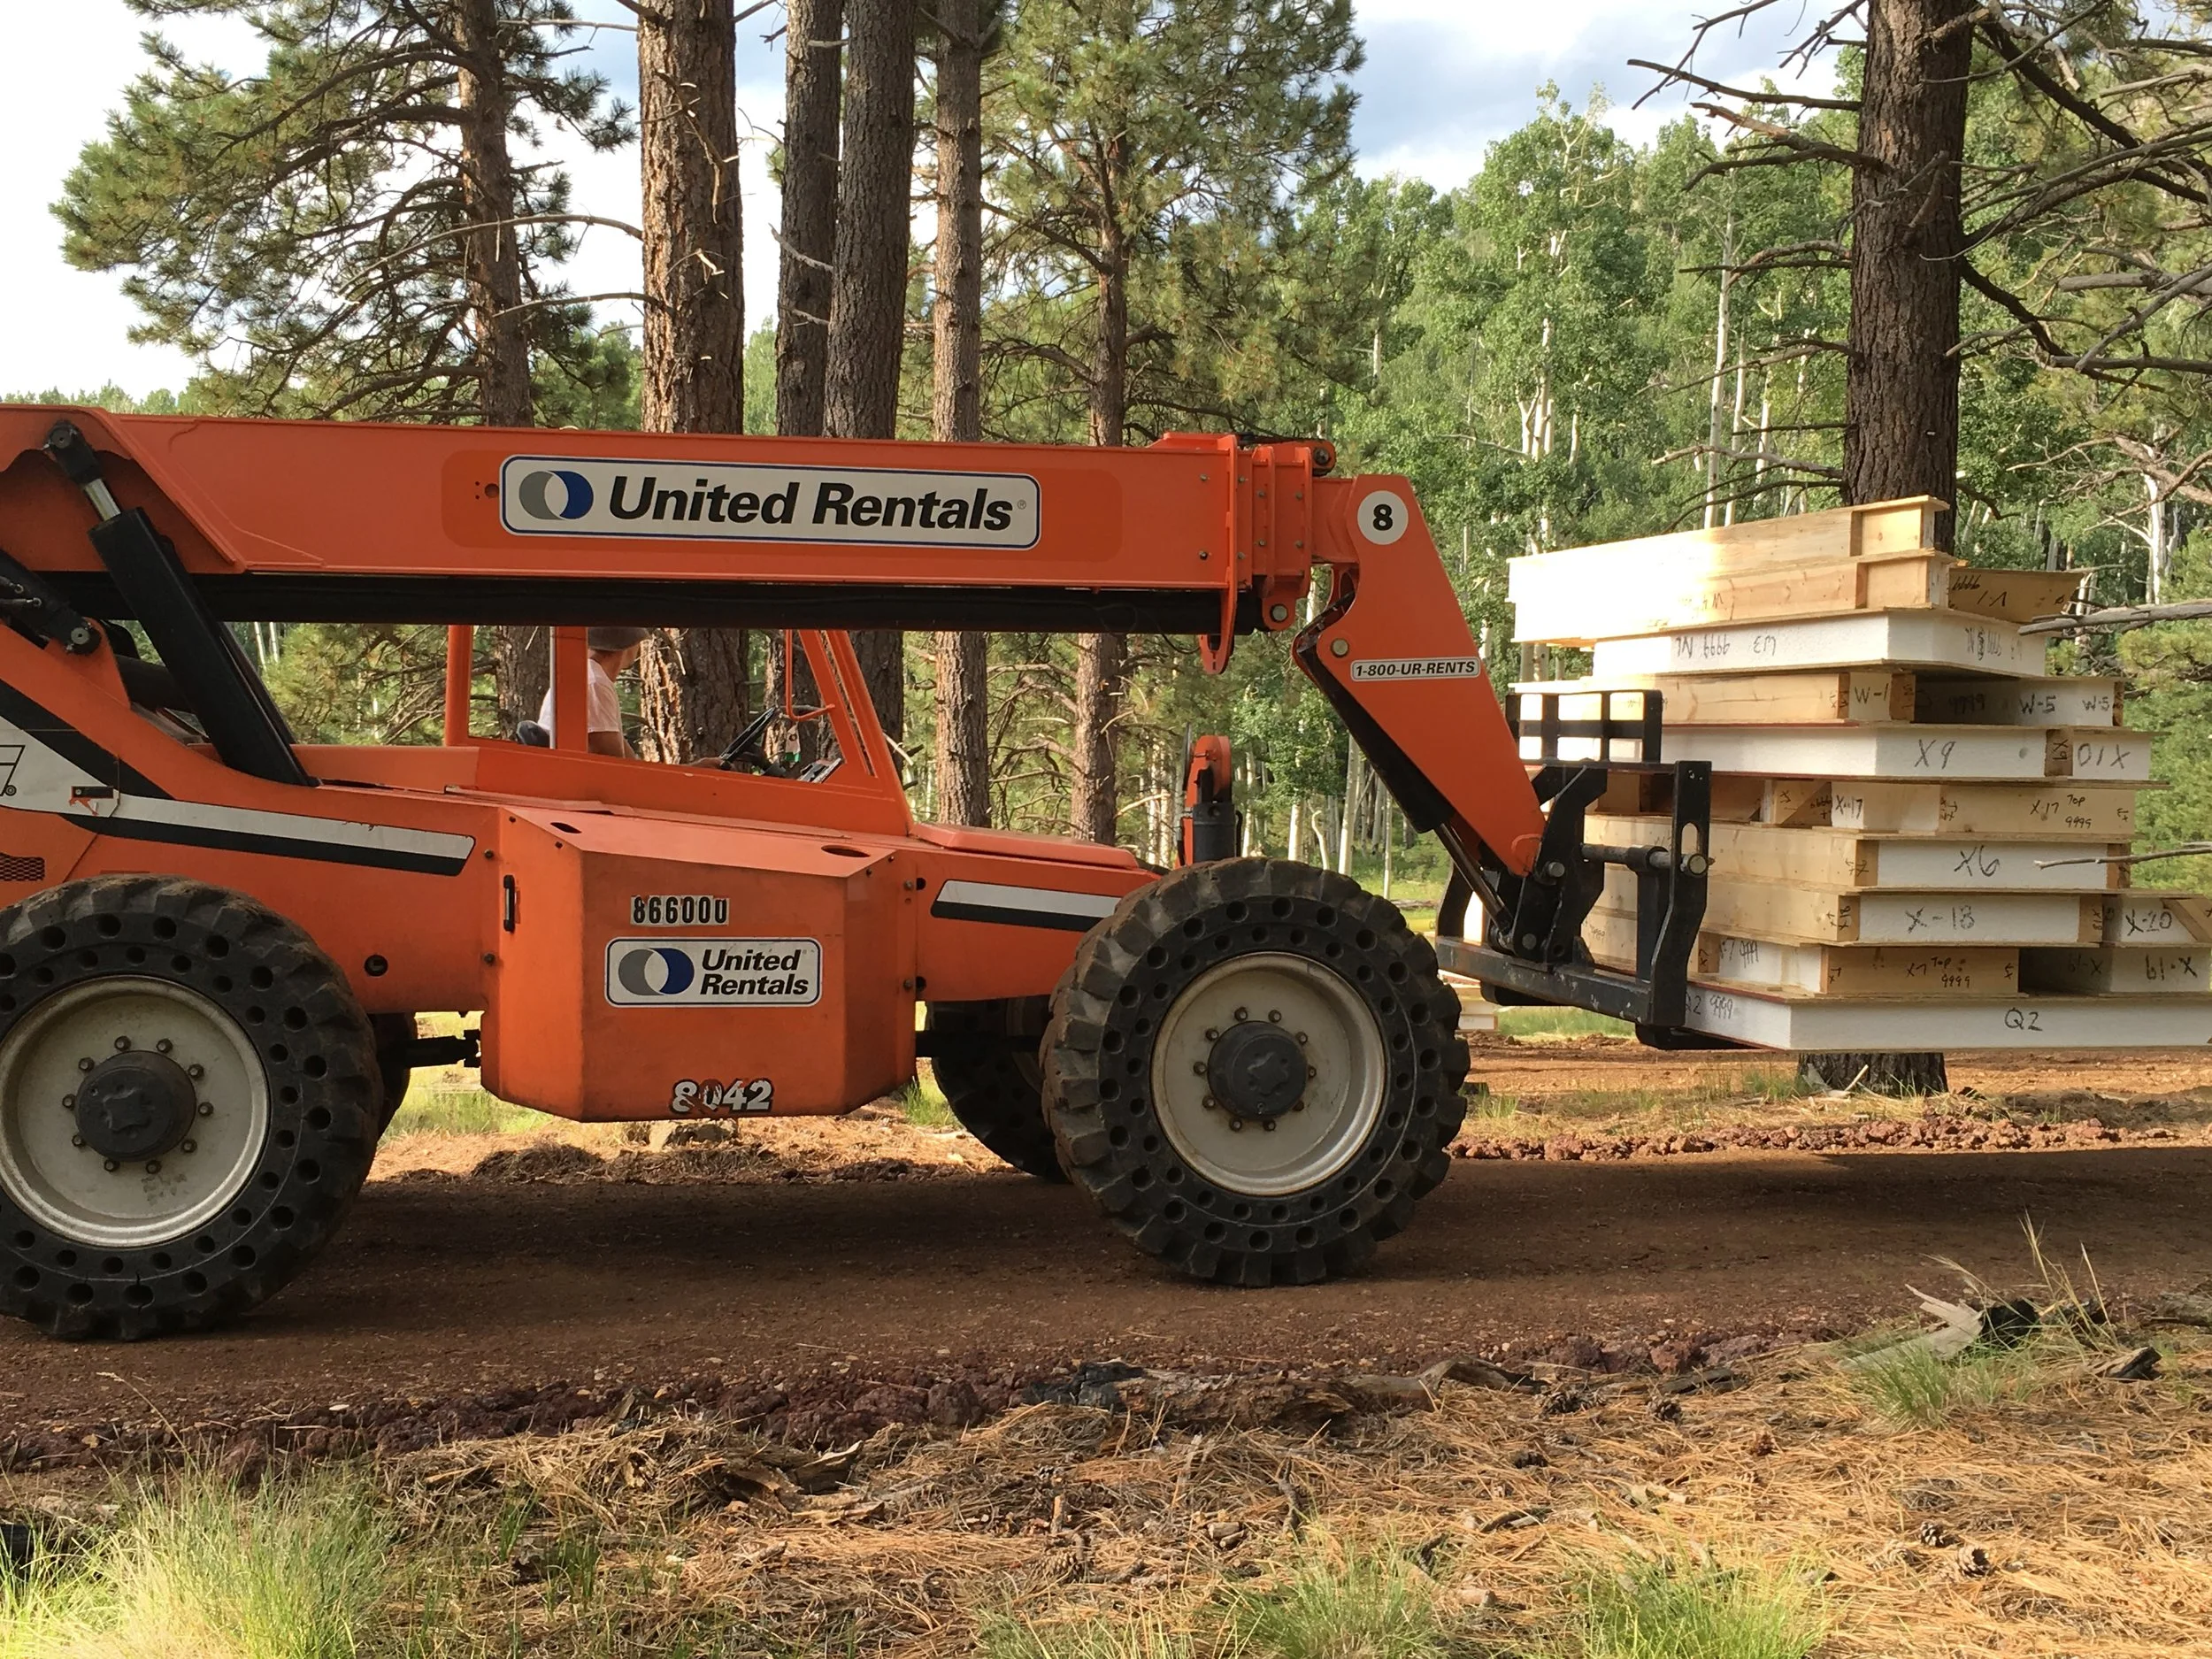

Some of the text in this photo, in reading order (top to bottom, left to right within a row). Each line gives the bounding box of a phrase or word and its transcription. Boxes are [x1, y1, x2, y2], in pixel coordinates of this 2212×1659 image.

[609, 475, 1013, 532] United Rentals
[1372, 503, 1394, 531] 8
[1356, 661, 1475, 677] 1-800-UR-RENTS
[1855, 683, 1889, 704] W-1
[1915, 739, 1956, 770] X9
[1954, 845, 2000, 877] X6
[1905, 905, 1975, 933] X-18
[701, 949, 802, 972] United
[700, 973, 809, 996] Rentals
[2004, 1007, 2043, 1032] Q2
[670, 1077, 775, 1115] 8042
